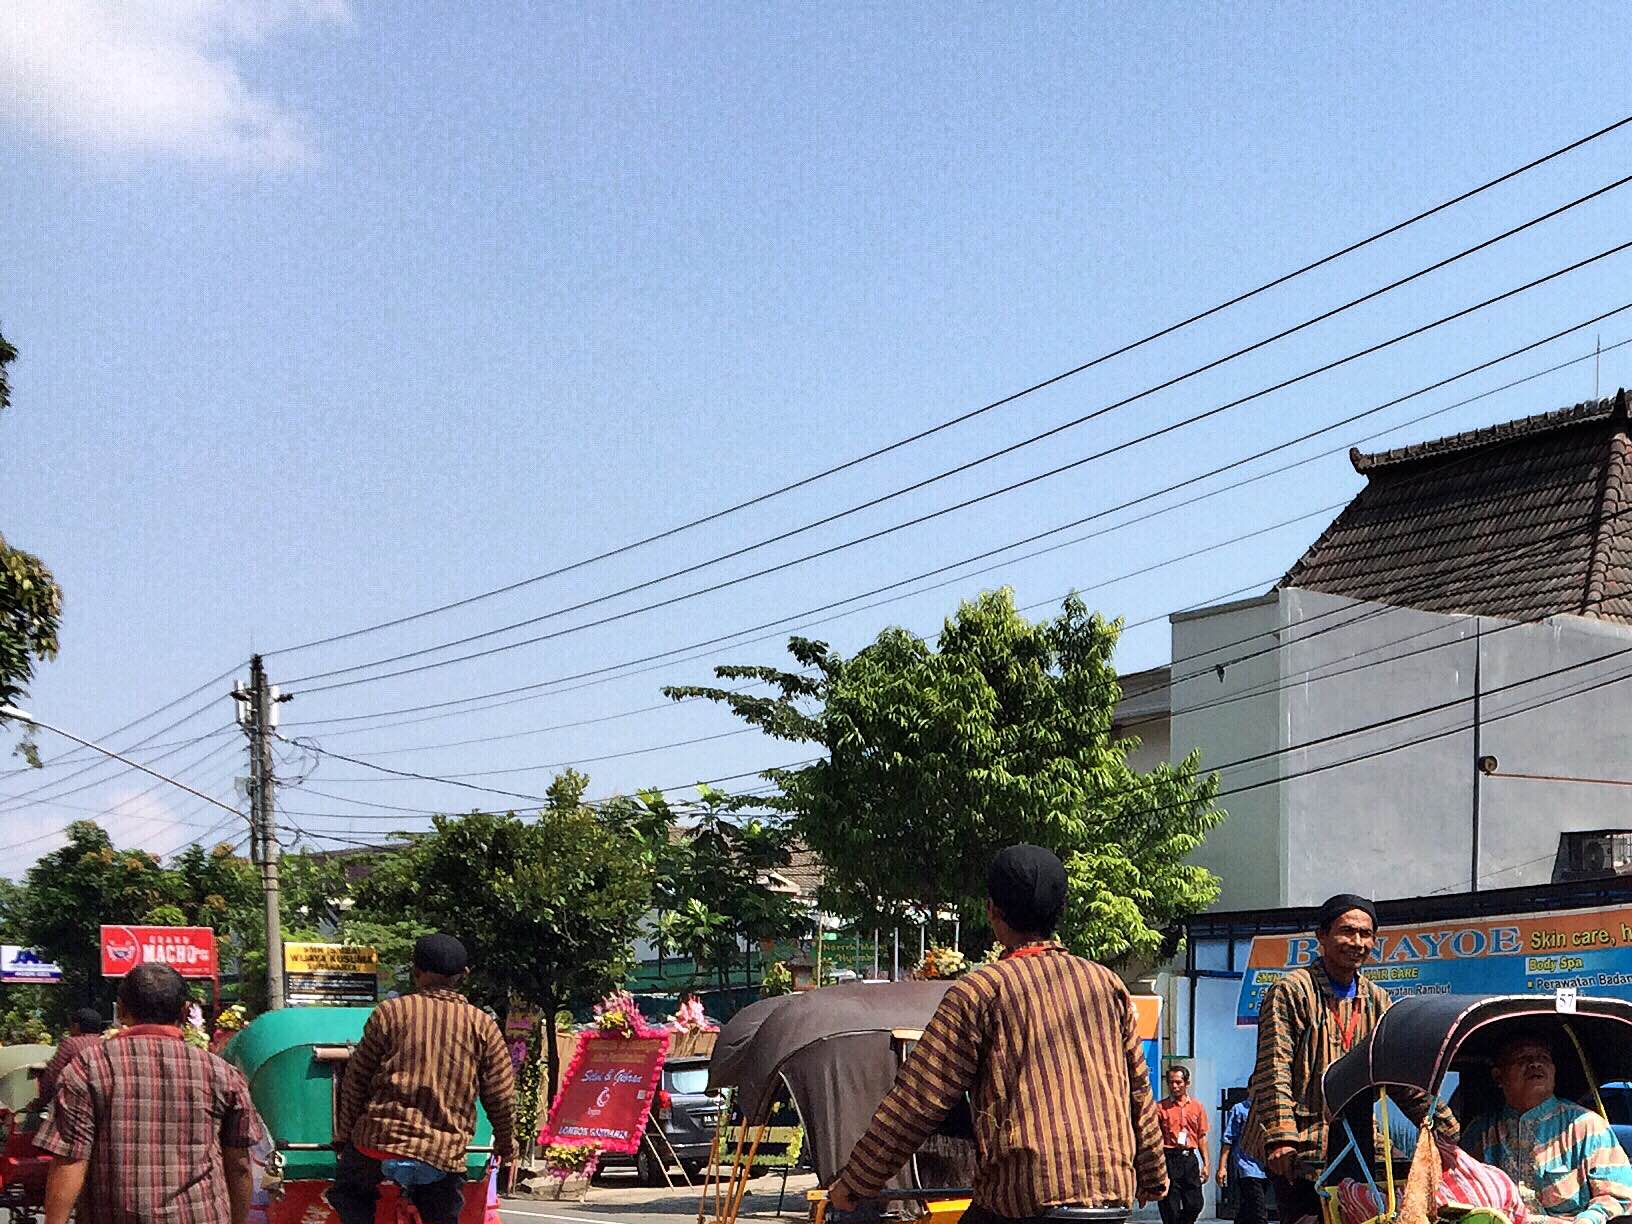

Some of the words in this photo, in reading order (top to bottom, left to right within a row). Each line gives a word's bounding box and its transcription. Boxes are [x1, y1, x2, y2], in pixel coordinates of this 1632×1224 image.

[1531, 931, 1567, 949] Skin
[1572, 928, 1616, 947] care,
[142, 944, 197, 963] MACHO
[1529, 957, 1556, 971] Body
[1559, 956, 1583, 972] Spa
[1391, 968, 1419, 979] CARE
[1537, 974, 1594, 989] Perawatan
